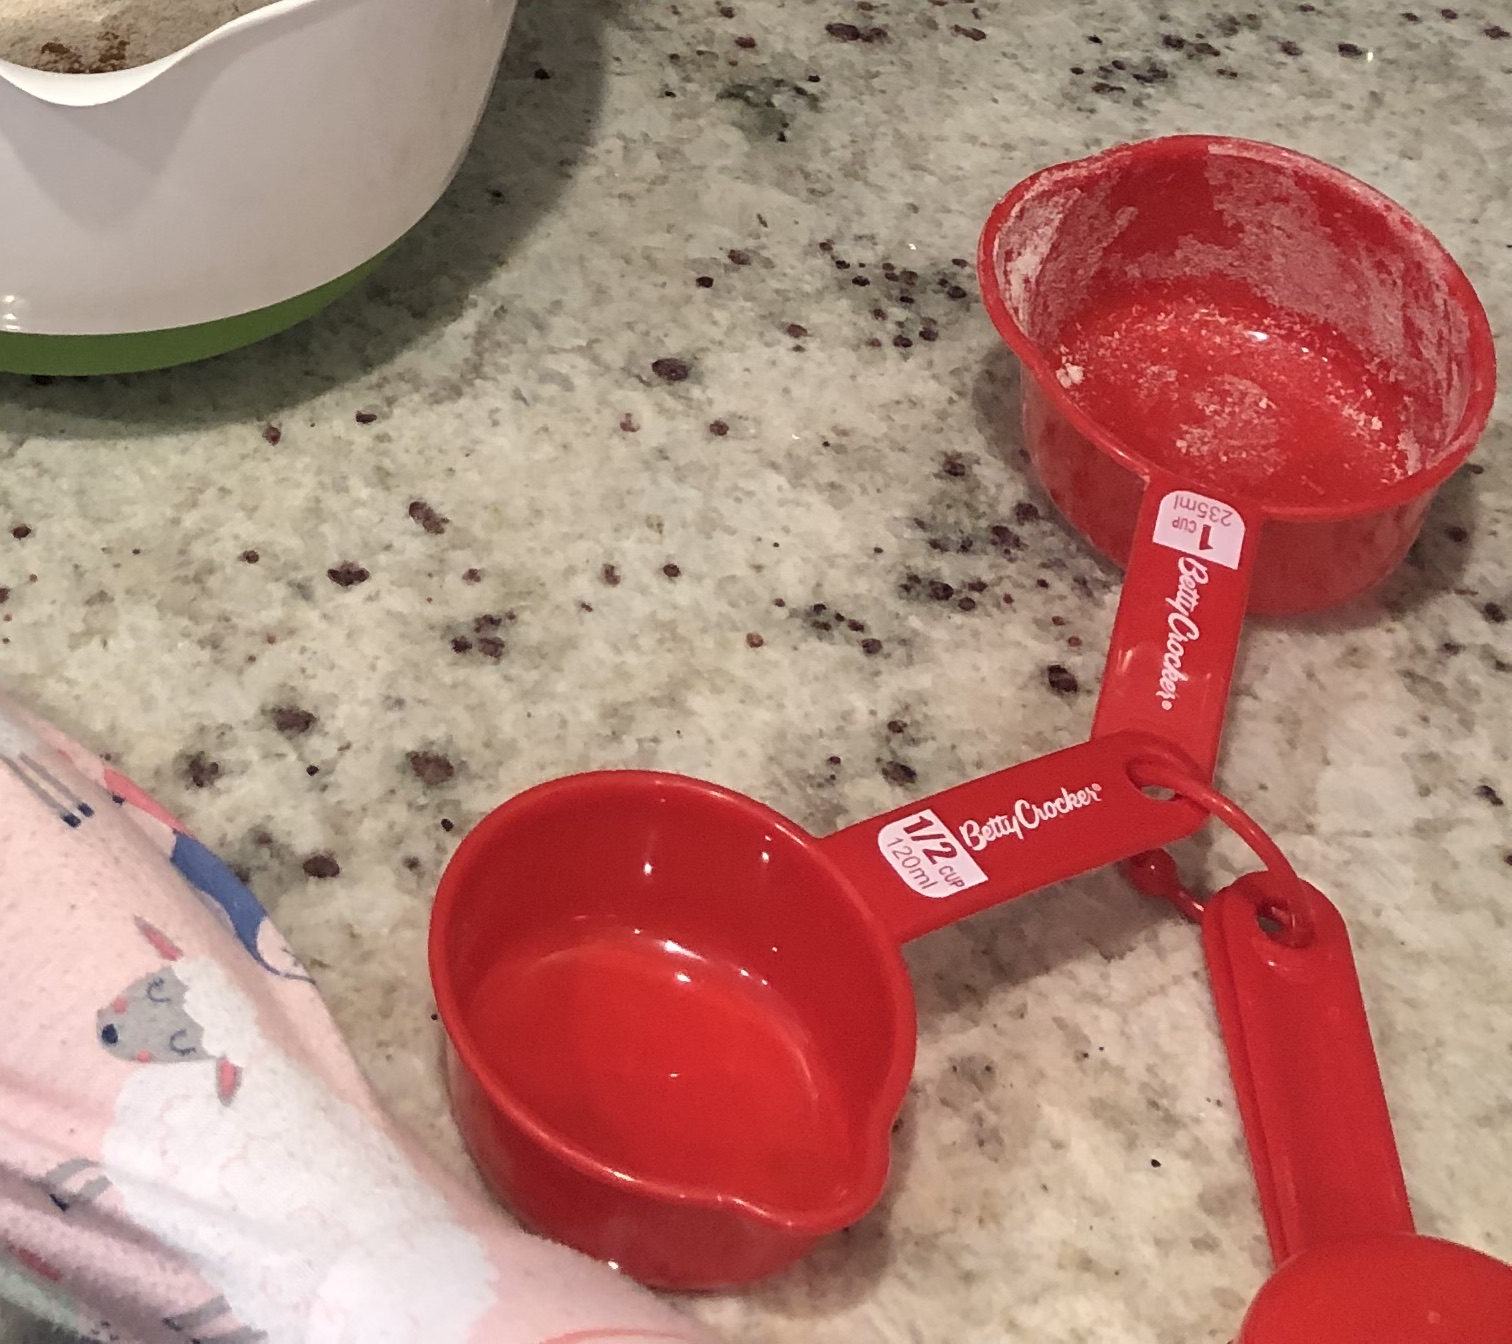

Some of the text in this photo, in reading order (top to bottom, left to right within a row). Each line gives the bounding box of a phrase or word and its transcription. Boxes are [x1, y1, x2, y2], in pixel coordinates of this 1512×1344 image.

[1171, 515, 1214, 551] 1 CUP
[1172, 494, 1233, 527] 235ml
[1165, 556, 1209, 614] Betty
[903, 815, 966, 889] 1/2 CUP
[958, 814, 1024, 851] Betty
[886, 836, 938, 890] 120ml
